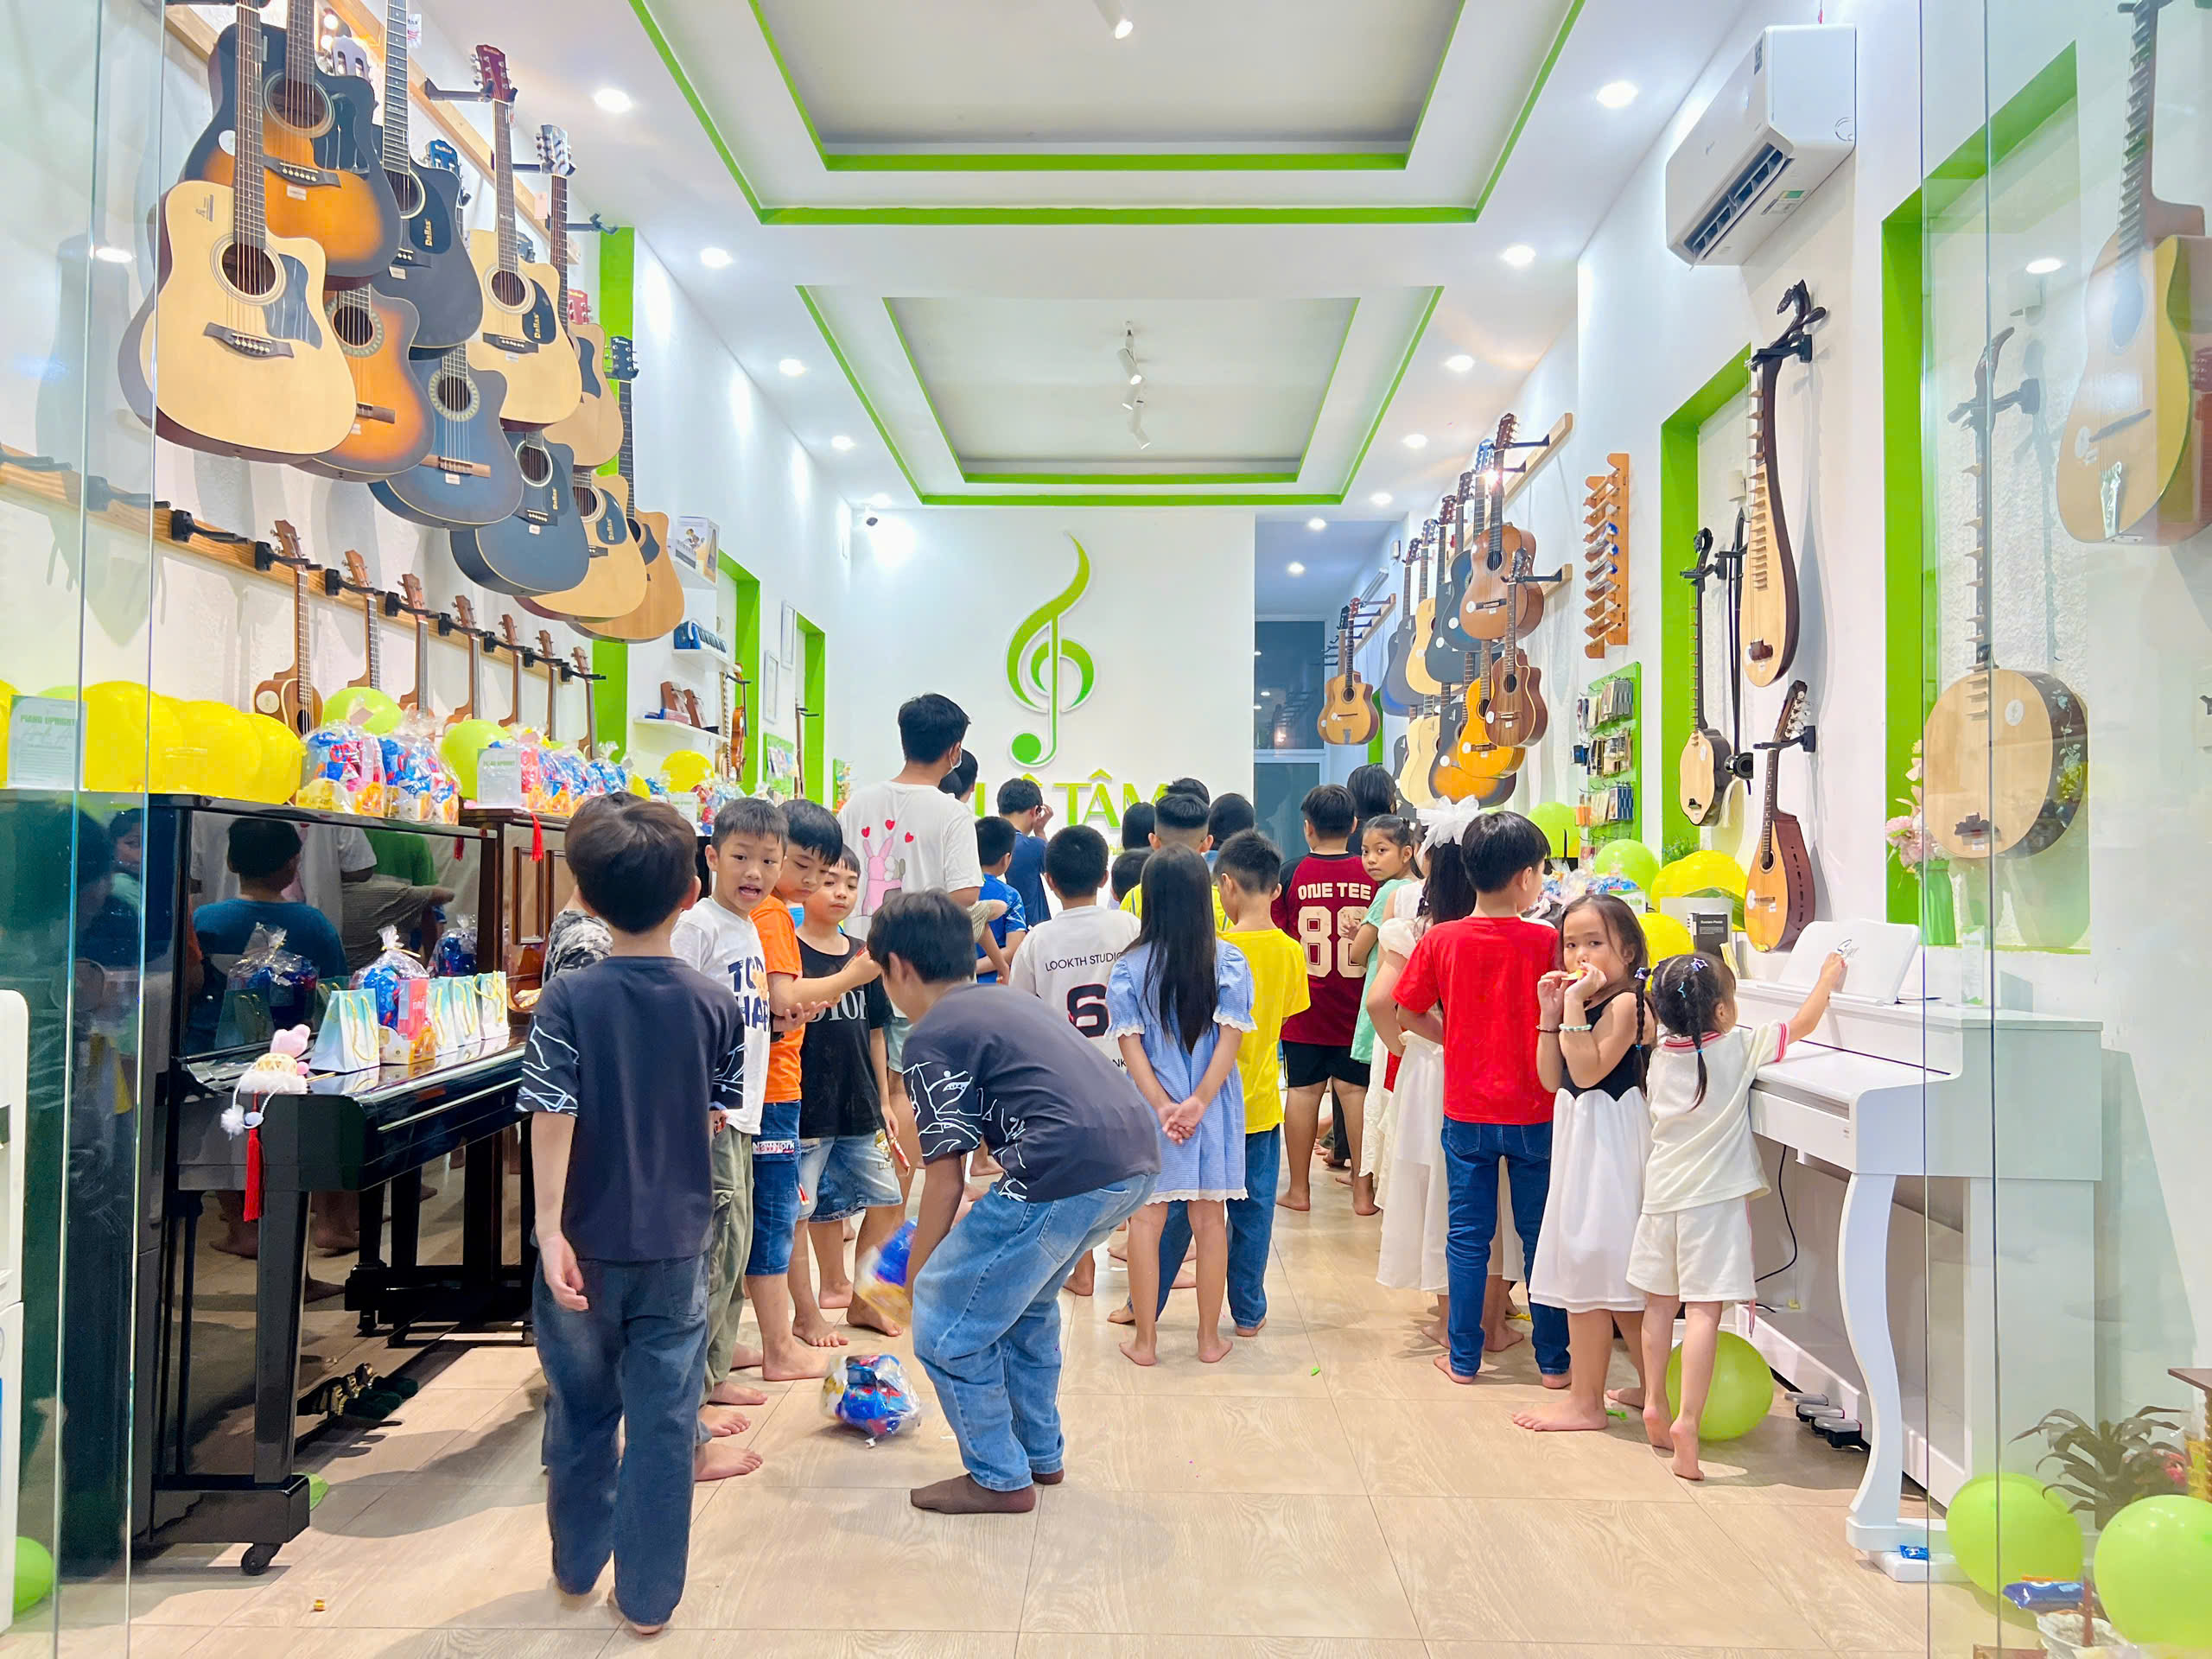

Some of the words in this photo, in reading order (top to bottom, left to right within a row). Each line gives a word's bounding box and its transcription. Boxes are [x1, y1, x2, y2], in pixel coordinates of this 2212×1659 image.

[1298, 882, 1333, 900] ONE
[1336, 882, 1371, 900] TEE
[1298, 906, 1370, 978] 88
[1066, 982, 1110, 1039] 6
